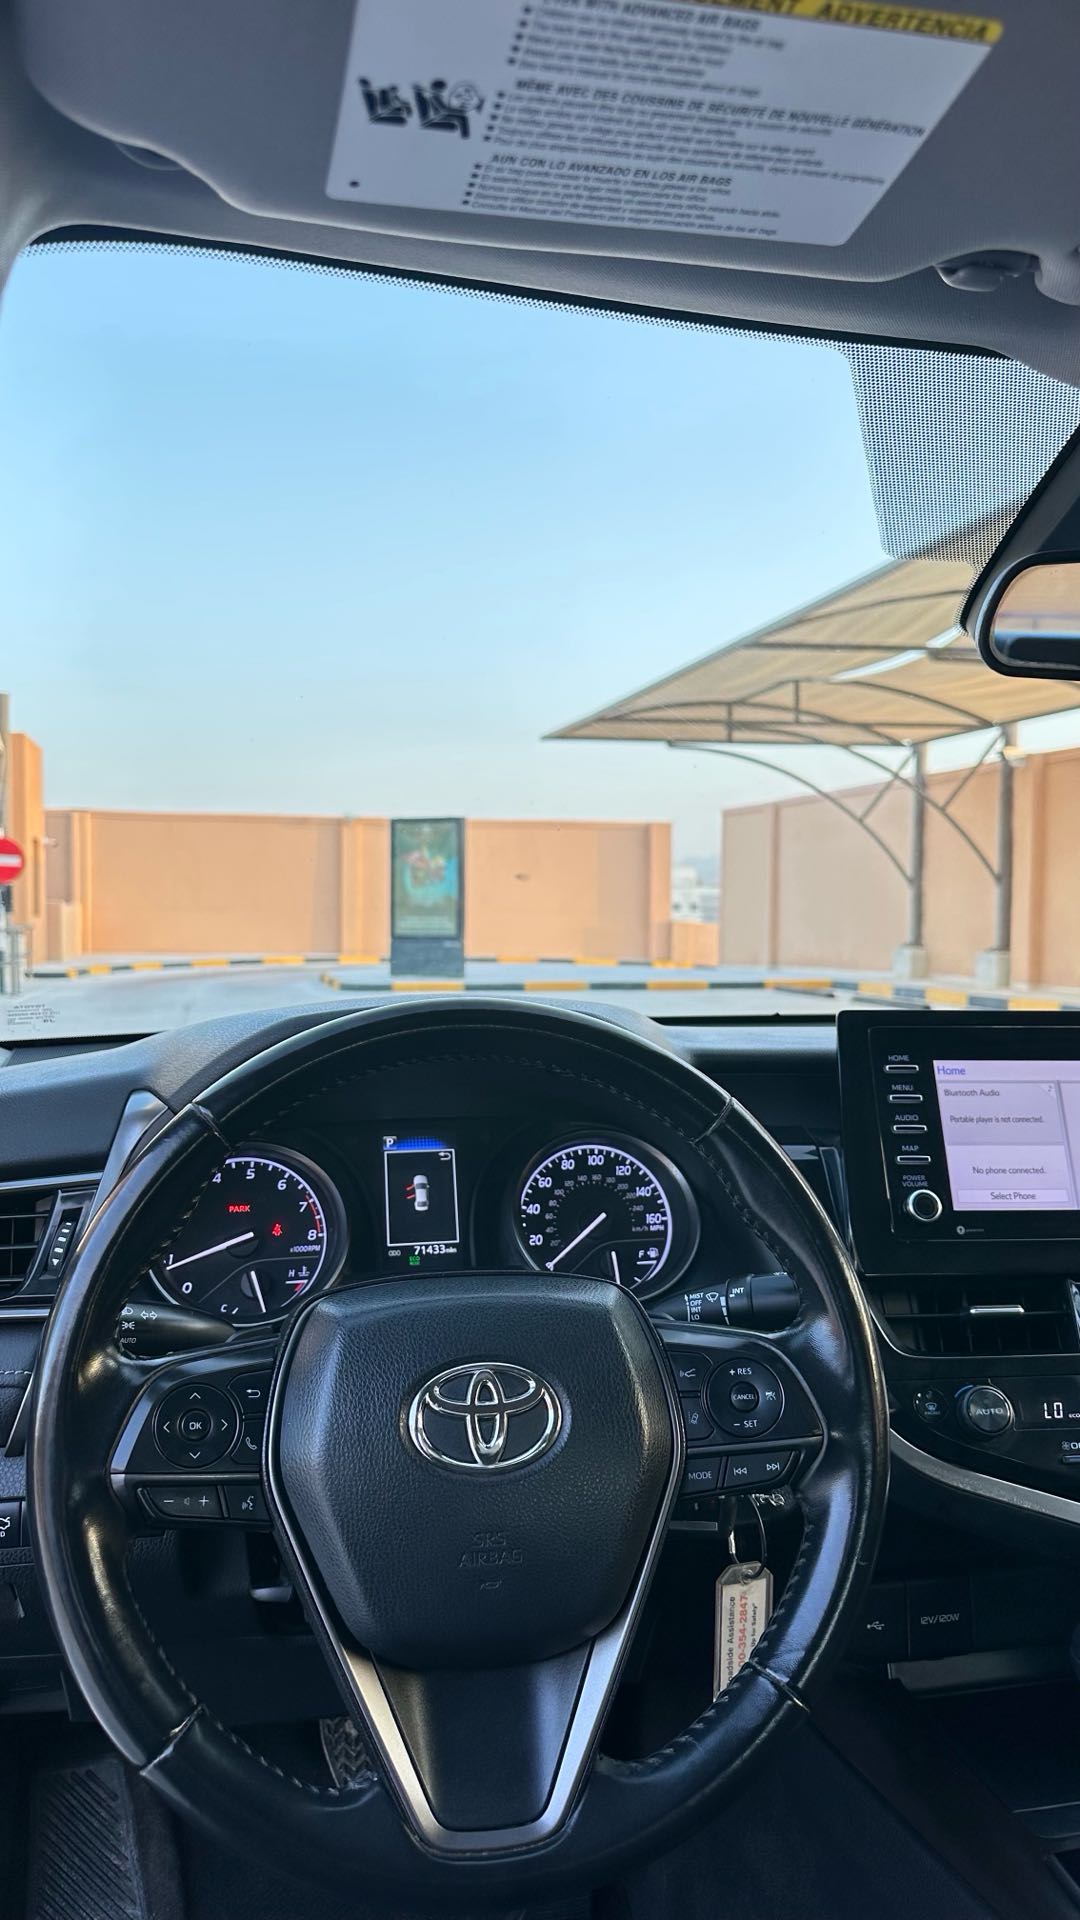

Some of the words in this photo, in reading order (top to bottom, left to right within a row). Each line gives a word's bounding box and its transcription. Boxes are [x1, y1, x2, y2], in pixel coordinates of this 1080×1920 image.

[698, 13, 719, 27] AIR
[722, 16, 760, 32] BAGS
[816, 1, 988, 40] ADVERTENCIA
[557, 84, 590, 98] AVEC
[593, 88, 619, 101] DES
[622, 92, 685, 110] COUSSINS
[687, 101, 705, 113] DE
[769, 109, 786, 121] DE
[789, 110, 849, 129] NOUVELLE
[492, 153, 516, 165] AUN
[520, 157, 546, 168] CON
[551, 160, 566, 171] LO
[568, 162, 631, 178] AVANZADO
[633, 168, 649, 179] EN
[652, 170, 675, 182] LOS
[677, 172, 698, 185] AIR
[699, 175, 733, 188] BAGS
[888, 1054, 910, 1062] HOME
[937, 1065, 966, 1076] Home
[891, 1084, 914, 1092] MENU
[944, 1088, 978, 1097] Bluetooth
[980, 1088, 1000, 1097] Audio
[894, 1114, 919, 1122] AUDIO
[950, 1115, 974, 1123] Portable
[975, 1115, 994, 1124] player
[994, 1115, 1000, 1123] is
[1001, 1115, 1010, 1123] not
[1011, 1115, 1044, 1123] connected.
[385, 1138, 394, 1147] P
[560, 1159, 575, 1170] 80
[587, 1154, 605, 1166] 100
[246, 1168, 256, 1180] 5
[615, 1165, 632, 1177] 120
[972, 1166, 984, 1174] No
[985, 1166, 1007, 1176] phone
[1008, 1166, 1047, 1175] connected.
[211, 1173, 222, 1184] 4
[538, 1177, 552, 1189] 60
[902, 1180, 928, 1188] VOLUME
[277, 1179, 287, 1191] 6
[635, 1186, 652, 1197] 140
[990, 1192, 1012, 1201] Select
[1013, 1192, 1037, 1201] Phone
[228, 1205, 251, 1213] PARK
[299, 1202, 308, 1213] 7
[526, 1203, 541, 1215] 40
[646, 1213, 662, 1224] 160
[649, 1224, 665, 1232] MPH
[307, 1229, 317, 1241] 8
[529, 1234, 543, 1246] 20
[388, 1249, 401, 1257] ODO
[413, 1245, 446, 1256] 71433
[638, 1250, 644, 1258] F
[168, 1254, 174, 1265] 1
[288, 1270, 295, 1278] H
[182, 1282, 193, 1294] 0
[689, 1292, 704, 1300] MIST
[220, 1304, 228, 1313] C
[119, 1336, 137, 1344] AUTO
[737, 1367, 753, 1376] RES
[732, 1393, 755, 1401] CANCEL
[976, 1407, 1004, 1416] AUTO
[1043, 1402, 1064, 1419] LO
[189, 1421, 202, 1430] OK
[743, 1419, 758, 1428] SET
[688, 1471, 713, 1480] MODE
[728, 1597, 736, 1644] Assistance
[920, 1612, 960, 1625] 12V/120W
[726, 1647, 734, 1683] oadside
